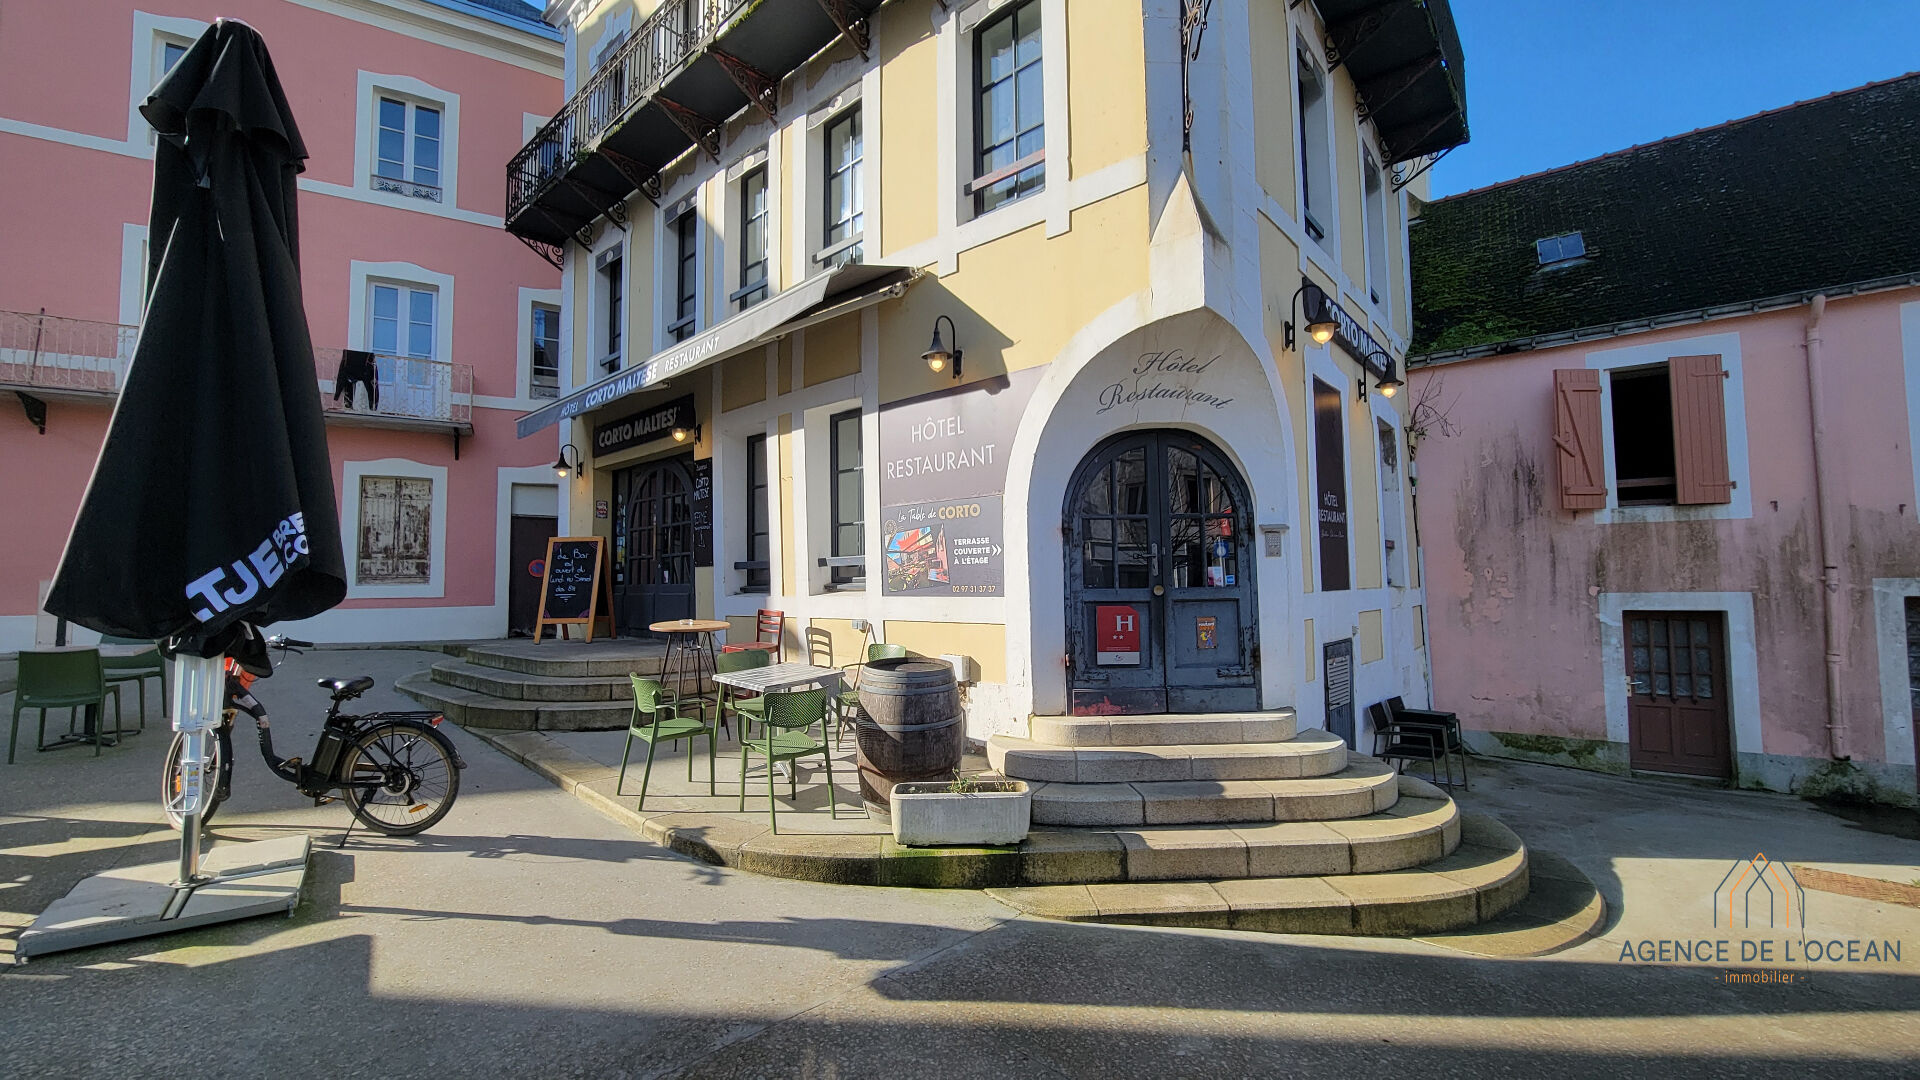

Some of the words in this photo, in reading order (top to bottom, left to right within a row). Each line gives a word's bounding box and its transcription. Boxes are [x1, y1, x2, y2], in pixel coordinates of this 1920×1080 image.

[1132, 349, 1222, 374] Hôtel
[585, 384, 615, 408] CORTO
[615, 362, 658, 396] MALTESE
[664, 336, 720, 373] RESTAURANT
[1096, 377, 1234, 415] Restaurant
[599, 423, 632, 448] CORTO
[911, 415, 965, 443] HÔTEL
[887, 444, 995, 480] RESTAURANT
[1324, 490, 1338, 507] HÔTEL
[898, 509, 906, 523] La
[908, 506, 926, 523] Table
[928, 508, 937, 519] de
[938, 503, 981, 520] CORTO
[1318, 509, 1346, 523] RESTAURANT
[953, 537, 990, 546] TERRASSE
[573, 548, 589, 559] Bar
[953, 546, 991, 556] COUVERTE
[954, 556, 960, 565] À
[961, 556, 989, 565] L'ÉTAGE
[952, 585, 960, 593] 02
[961, 585, 969, 593] 97
[970, 585, 977, 593] 31
[979, 585, 987, 593] 37
[988, 585, 996, 593] 37
[1116, 615, 1134, 632] H
